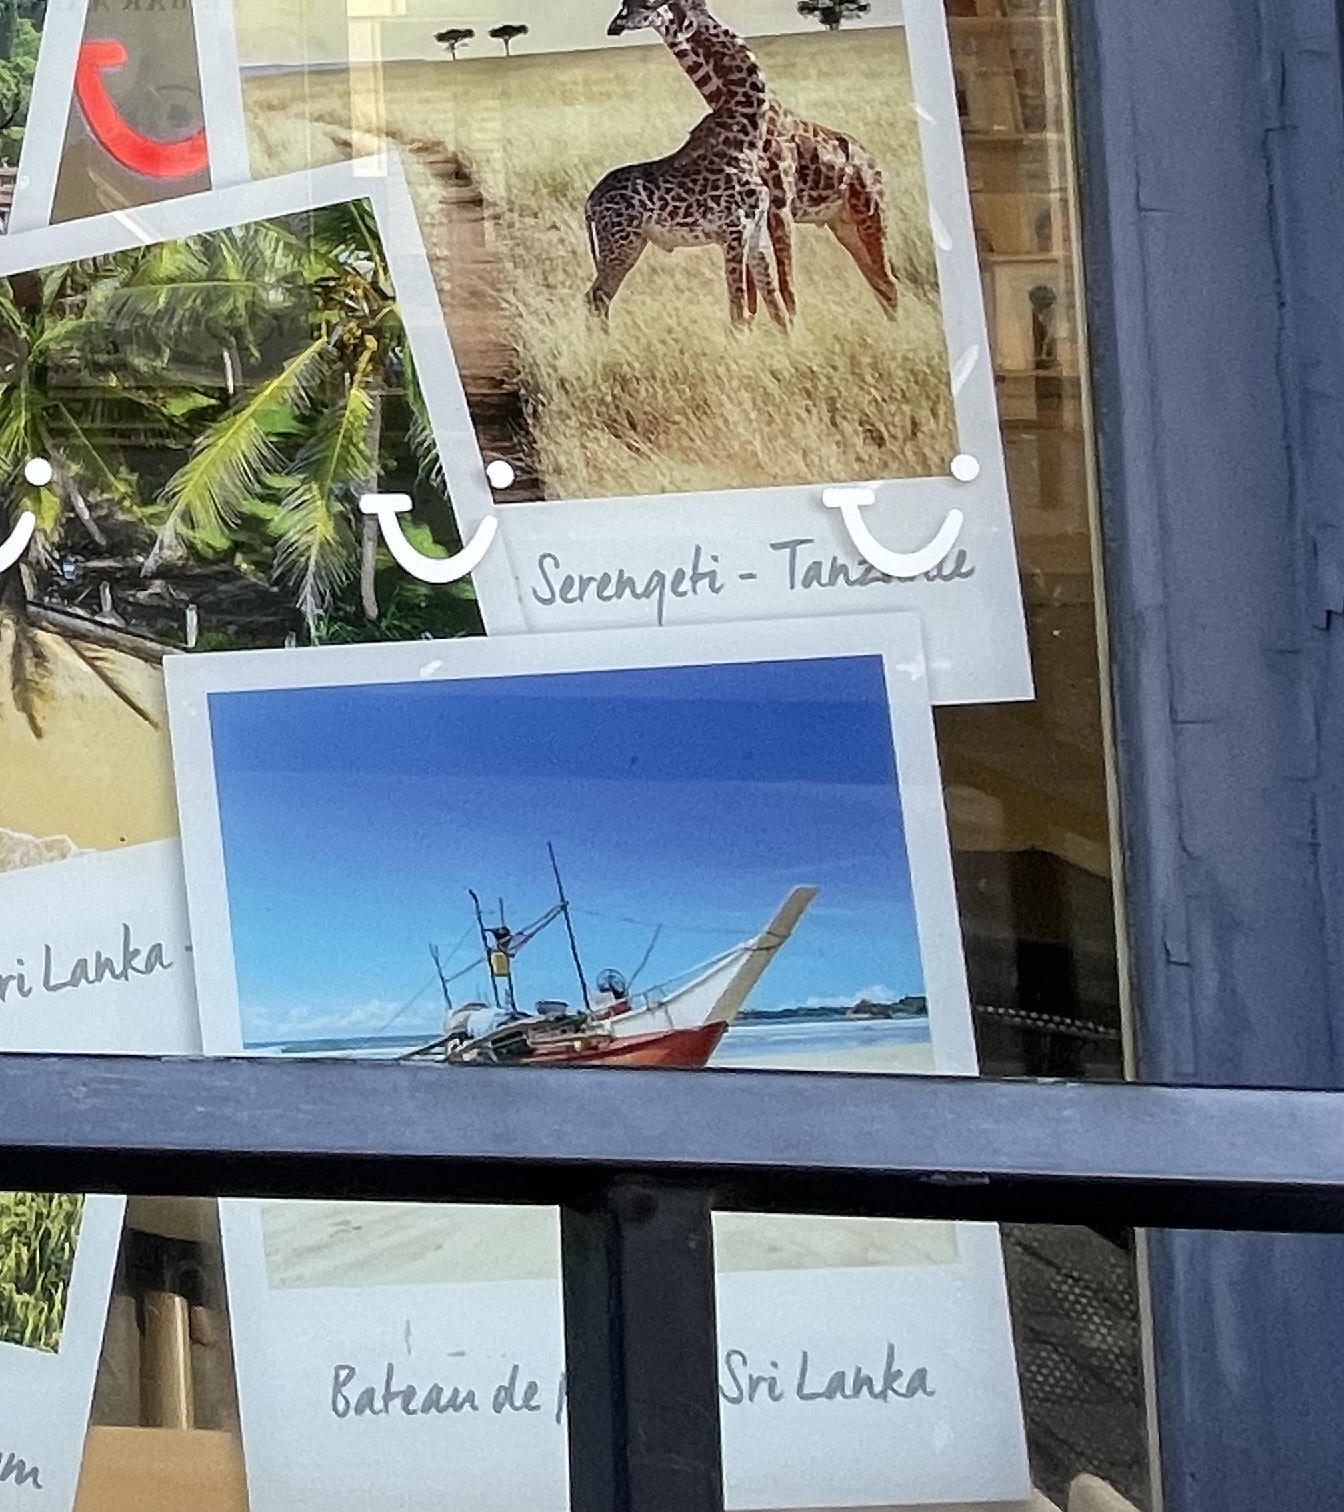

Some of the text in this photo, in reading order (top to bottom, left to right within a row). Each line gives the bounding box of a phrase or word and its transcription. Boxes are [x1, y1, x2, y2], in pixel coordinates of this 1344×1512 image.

[531, 545, 724, 628] Serengeti
[42, 922, 174, 992] Lanka
[332, 1362, 479, 1418] Bateau
[492, 1364, 542, 1414] de
[719, 1348, 785, 1404] Sri
[797, 1340, 936, 1403] Lanka
